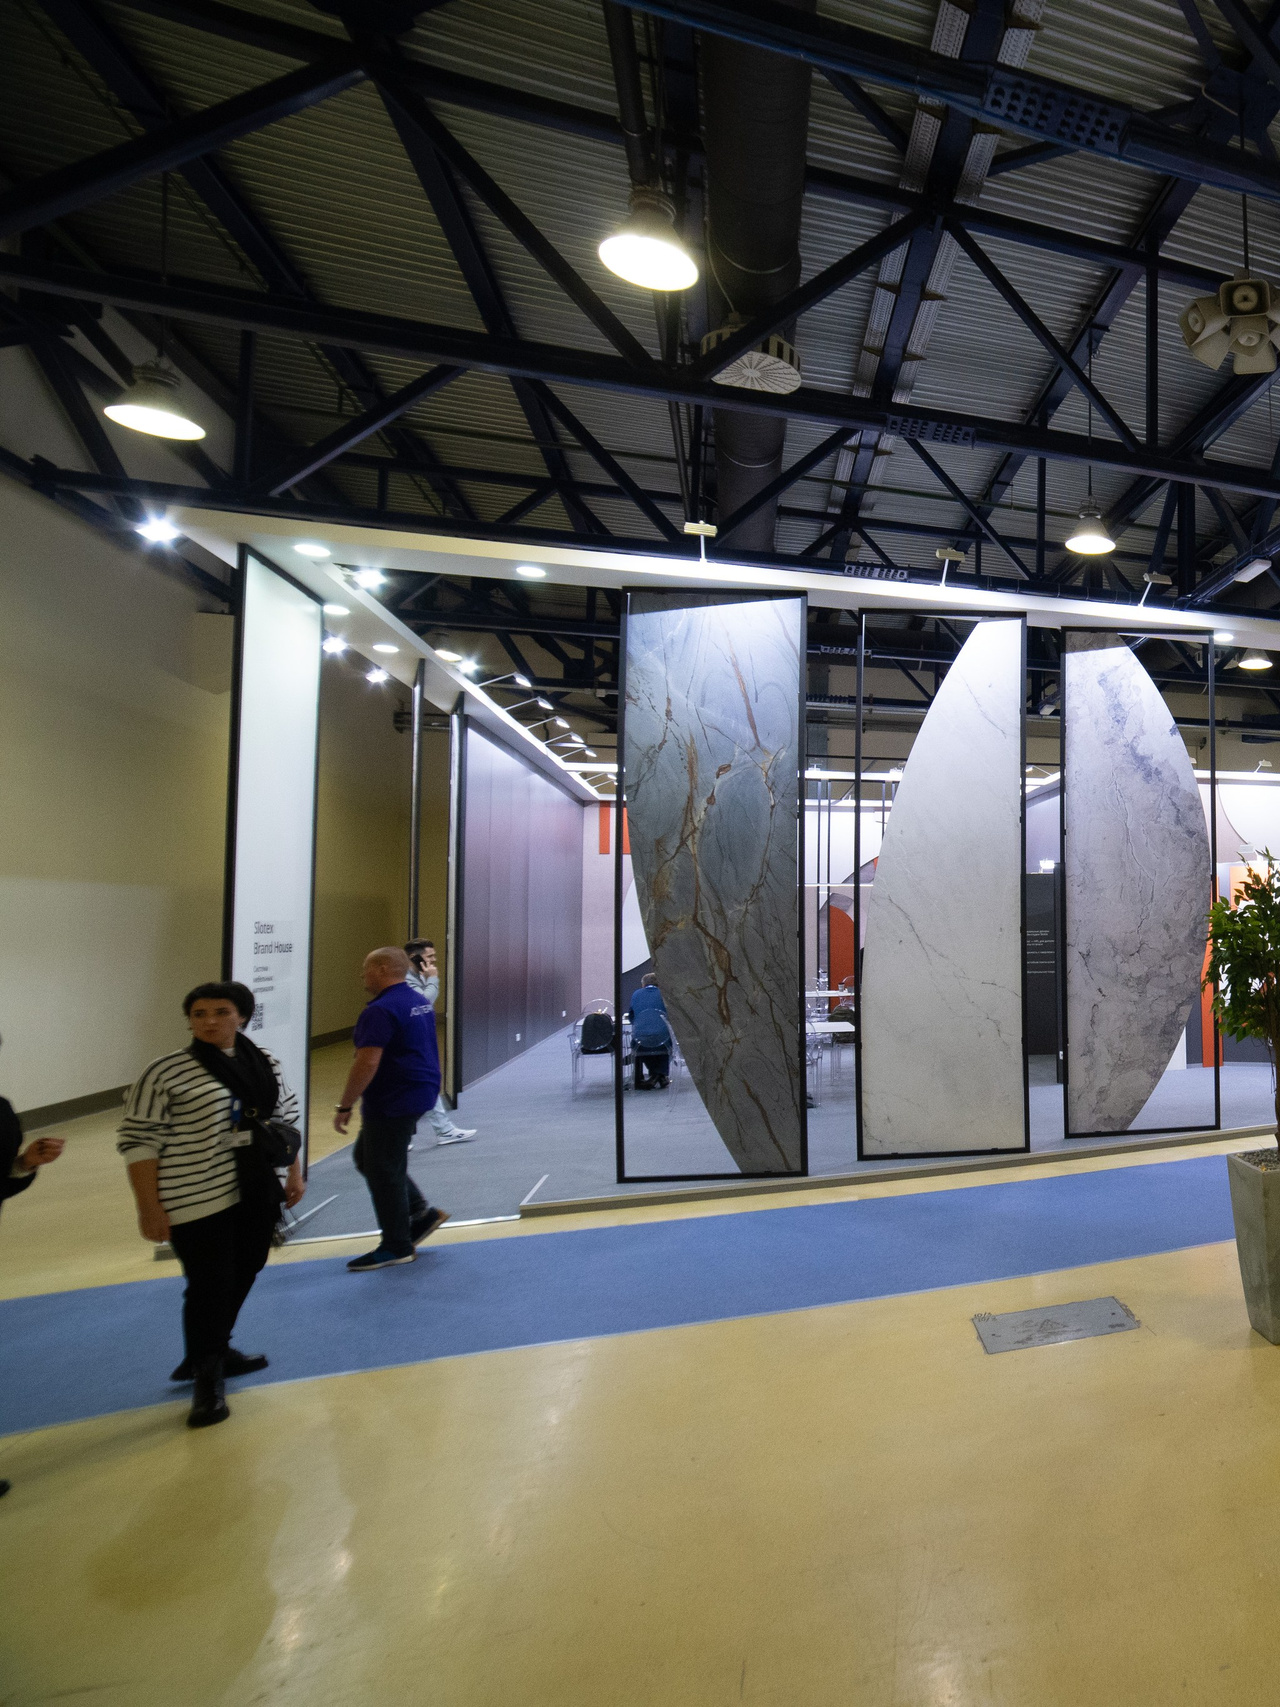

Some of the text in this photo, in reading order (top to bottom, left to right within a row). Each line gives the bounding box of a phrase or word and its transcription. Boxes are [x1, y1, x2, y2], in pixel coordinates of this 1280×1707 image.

[254, 921, 274, 935] Slotex
[253, 942, 293, 955] Brand House
